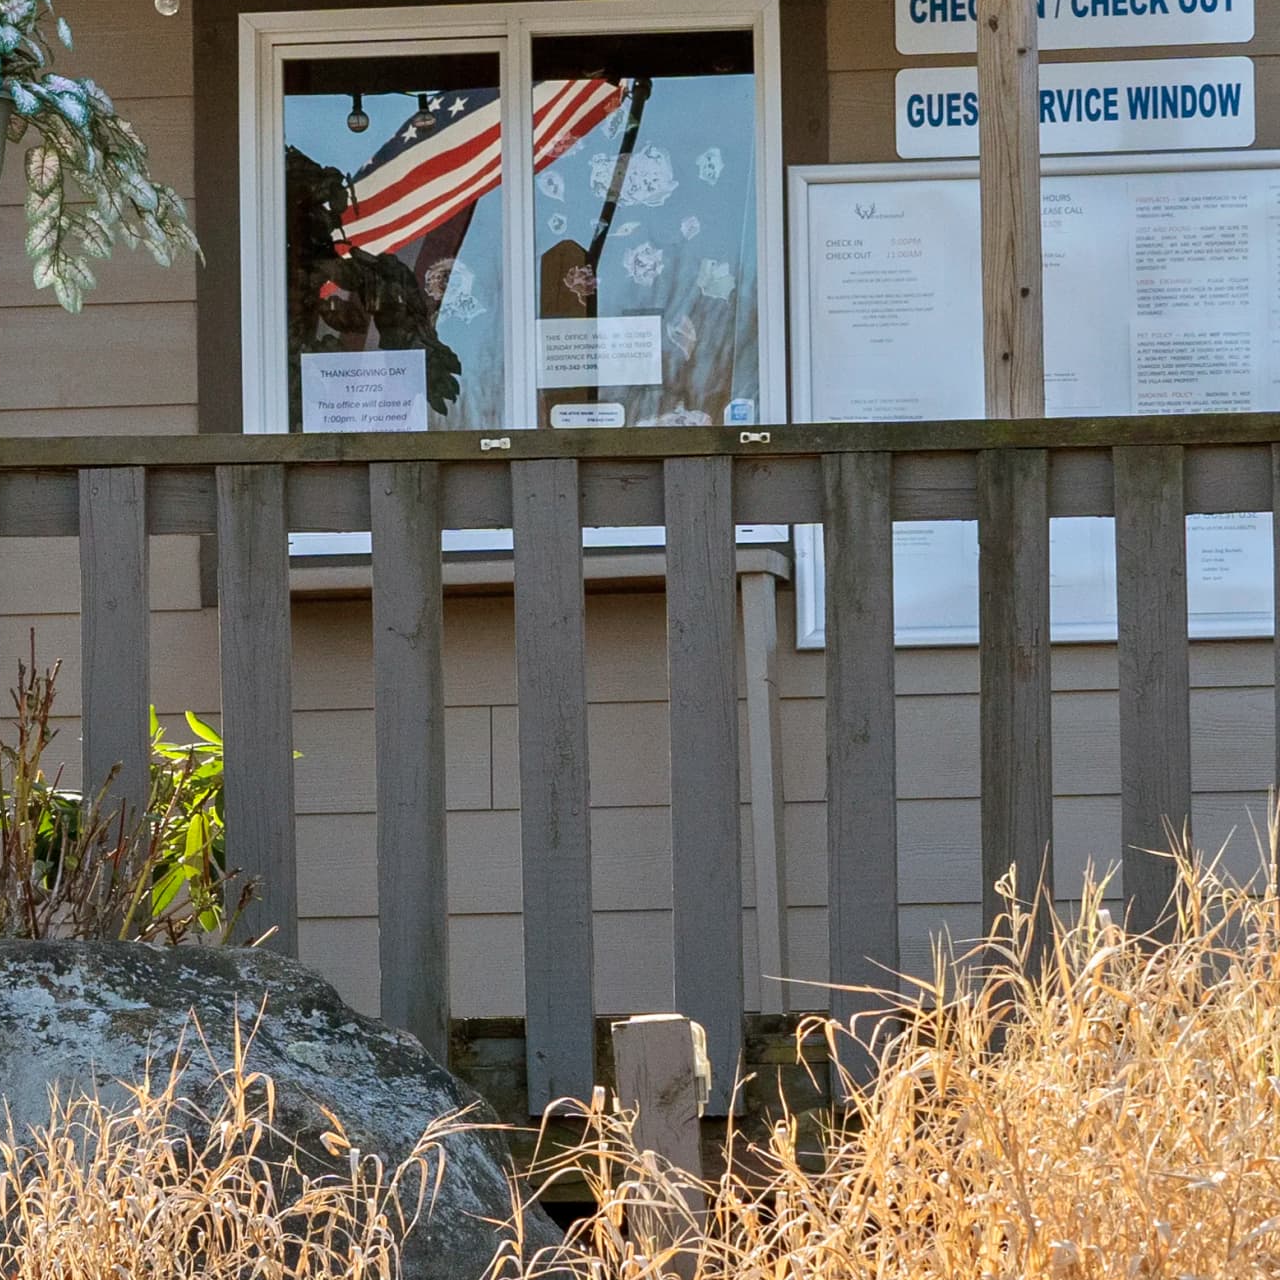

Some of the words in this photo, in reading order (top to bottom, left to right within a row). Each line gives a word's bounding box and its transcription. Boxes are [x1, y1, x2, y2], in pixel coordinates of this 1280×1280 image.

[906, 91, 978, 127] GUES
[1039, 87, 1118, 123] RVICE
[1126, 83, 1241, 120] WINDOW
[825, 239, 853, 248] CHECK
[854, 239, 863, 247] IN
[825, 252, 853, 260] CHECK
[854, 251, 872, 259] OUT
[320, 368, 387, 378] THANKSGIVING
[388, 367, 407, 376] DAY
[345, 383, 383, 392] 11/27/25
[318, 401, 335, 409] This
[336, 400, 361, 409] office
[362, 400, 377, 408] will
[378, 399, 401, 408] close
[402, 399, 412, 407] at
[368, 414, 384, 423] you
[385, 413, 408, 421] need
